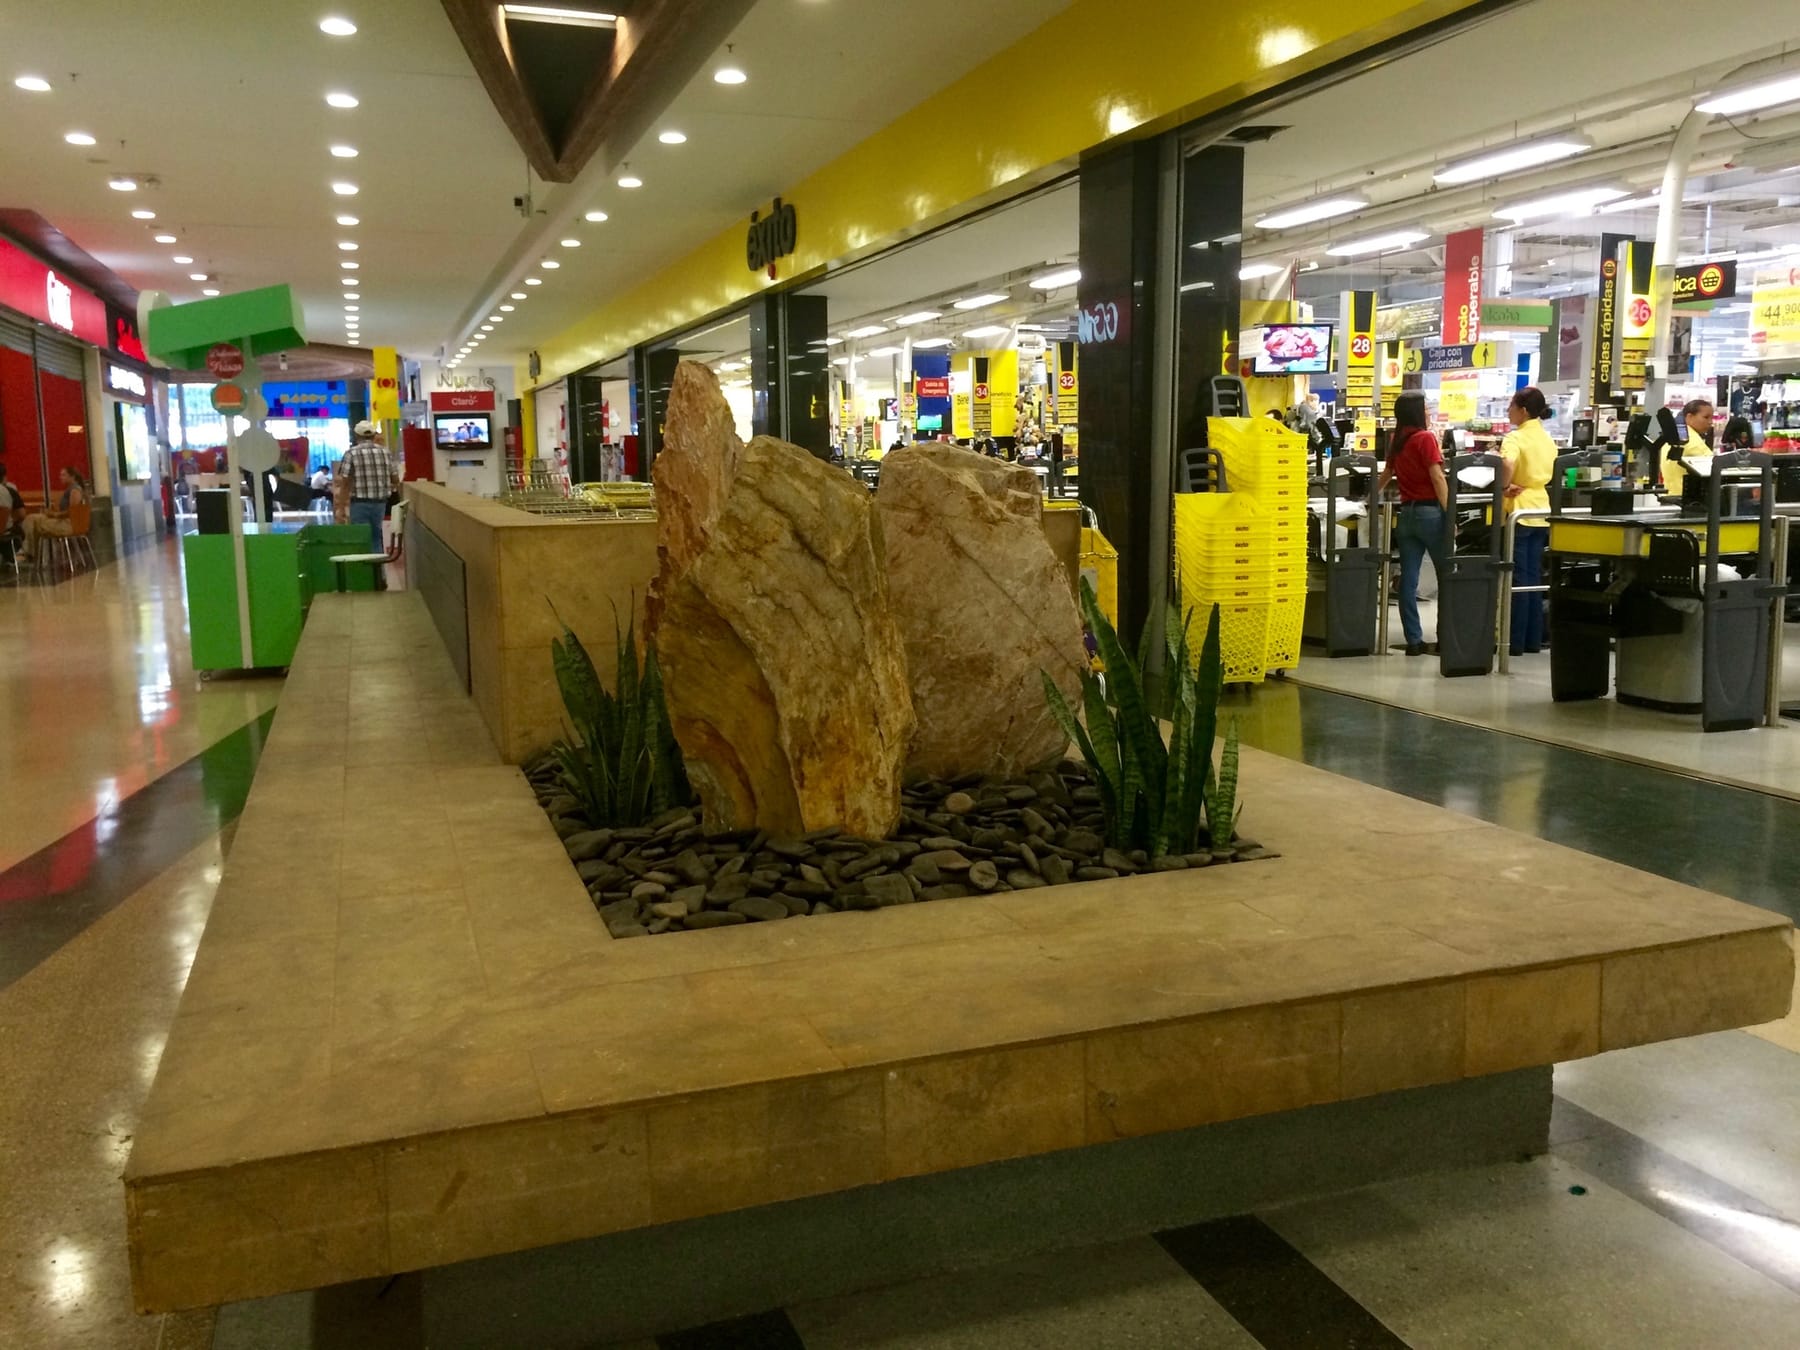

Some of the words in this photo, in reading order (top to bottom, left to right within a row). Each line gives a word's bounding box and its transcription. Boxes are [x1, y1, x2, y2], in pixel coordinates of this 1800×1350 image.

[1600, 279, 1614, 339] rápidas
[1629, 303, 1650, 321] 26
[1352, 338, 1371, 353] 28
[1428, 347, 1446, 359] Caja
[1447, 347, 1462, 357] con
[1428, 357, 1463, 370] prioridad
[1599, 341, 1611, 383] cajas
[1060, 375, 1074, 387] 32
[976, 387, 987, 397] 34
[451, 397, 474, 406] Claro
